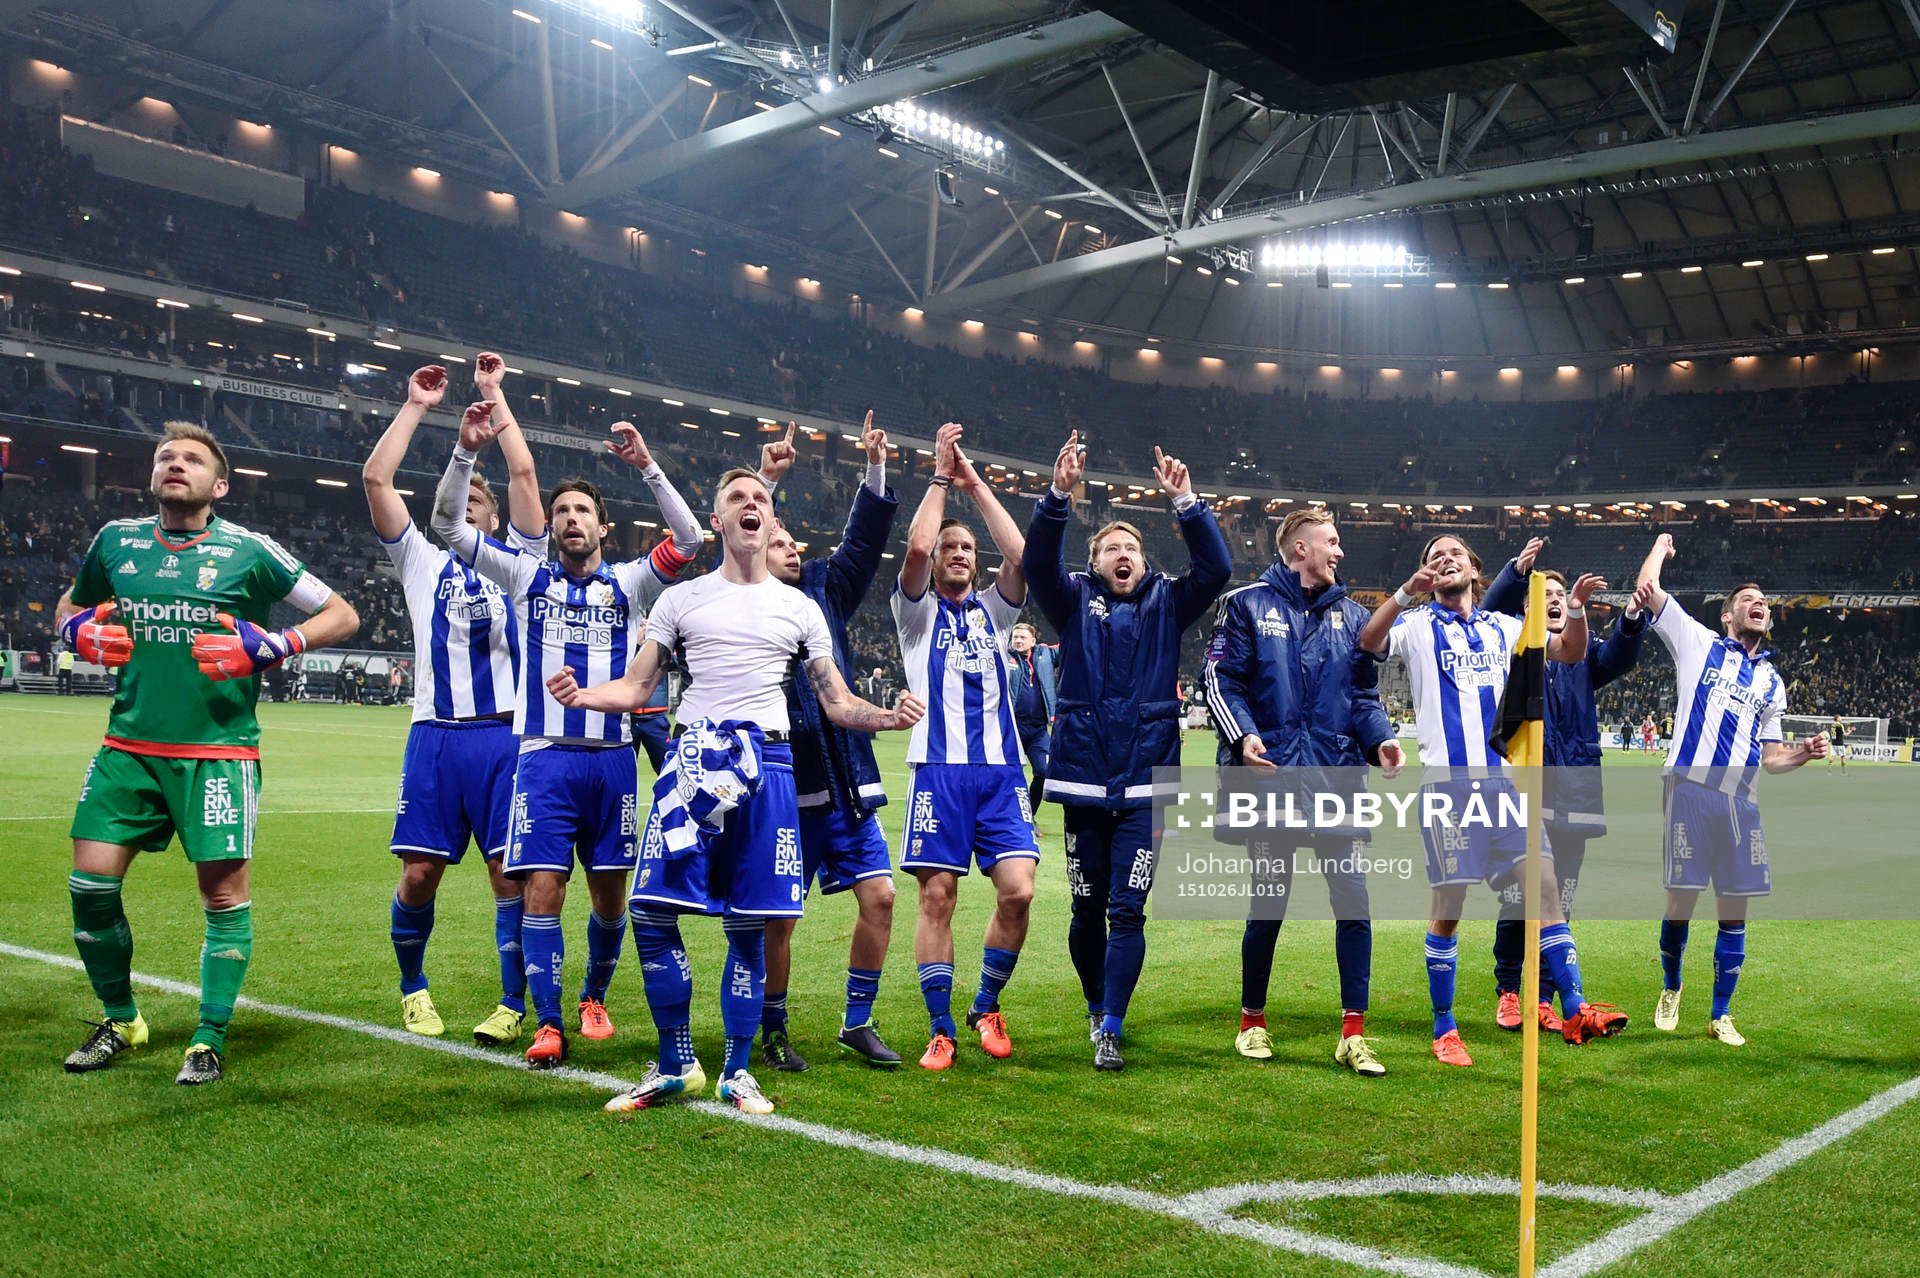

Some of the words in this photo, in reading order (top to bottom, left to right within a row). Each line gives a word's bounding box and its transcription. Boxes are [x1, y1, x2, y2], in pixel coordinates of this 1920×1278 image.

[222, 379, 287, 400] BUSINESS
[289, 391, 323, 406] CLUB
[524, 431, 545, 441] EST
[548, 435, 591, 448] LOUNGE
[121, 597, 218, 622] Prioritet
[447, 601, 505, 619] Finans
[535, 598, 623, 626] Prioritet
[544, 622, 610, 645] Finans
[1257, 619, 1290, 631] Prioritet
[1262, 629, 1287, 639] Finans
[946, 650, 995, 672] Finans
[205, 778, 228, 793] SE
[203, 793, 231, 809] RN
[622, 794, 635, 808] SE
[915, 791, 933, 806] SE
[203, 809, 238, 826] EKE
[914, 805, 932, 819] RN
[913, 818, 938, 833] EKE
[226, 834, 237, 852] 1
[777, 828, 795, 845] SE
[1444, 837, 1469, 851] EKE
[1750, 829, 1763, 842] SE
[776, 844, 797, 860] RN
[1135, 848, 1152, 864] SE
[775, 859, 801, 876] EKE
[1067, 857, 1081, 870] SE
[1131, 860, 1152, 877] RN
[790, 883, 800, 902] 8
[552, 951, 563, 986] SKF
[671, 948, 690, 982] SKF
[731, 961, 753, 999] SKF
